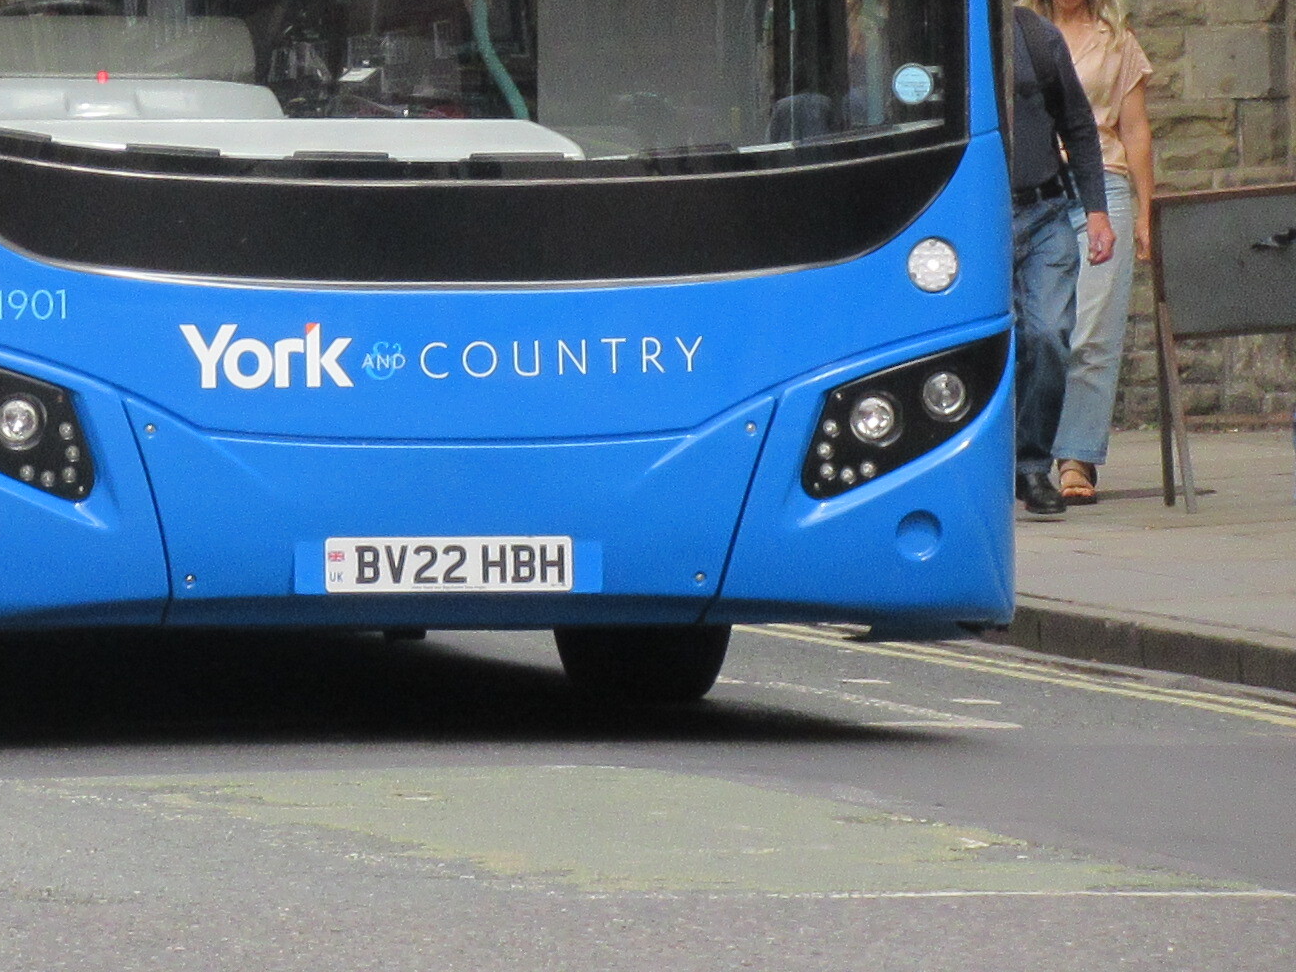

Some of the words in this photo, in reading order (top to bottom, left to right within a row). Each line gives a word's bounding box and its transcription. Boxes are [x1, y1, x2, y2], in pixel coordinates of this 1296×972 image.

[179, 321, 354, 390] York
[419, 334, 705, 381] COUNTRY
[328, 571, 345, 583] UK
[354, 543, 468, 585] BV22
[481, 543, 566, 585] HBH
